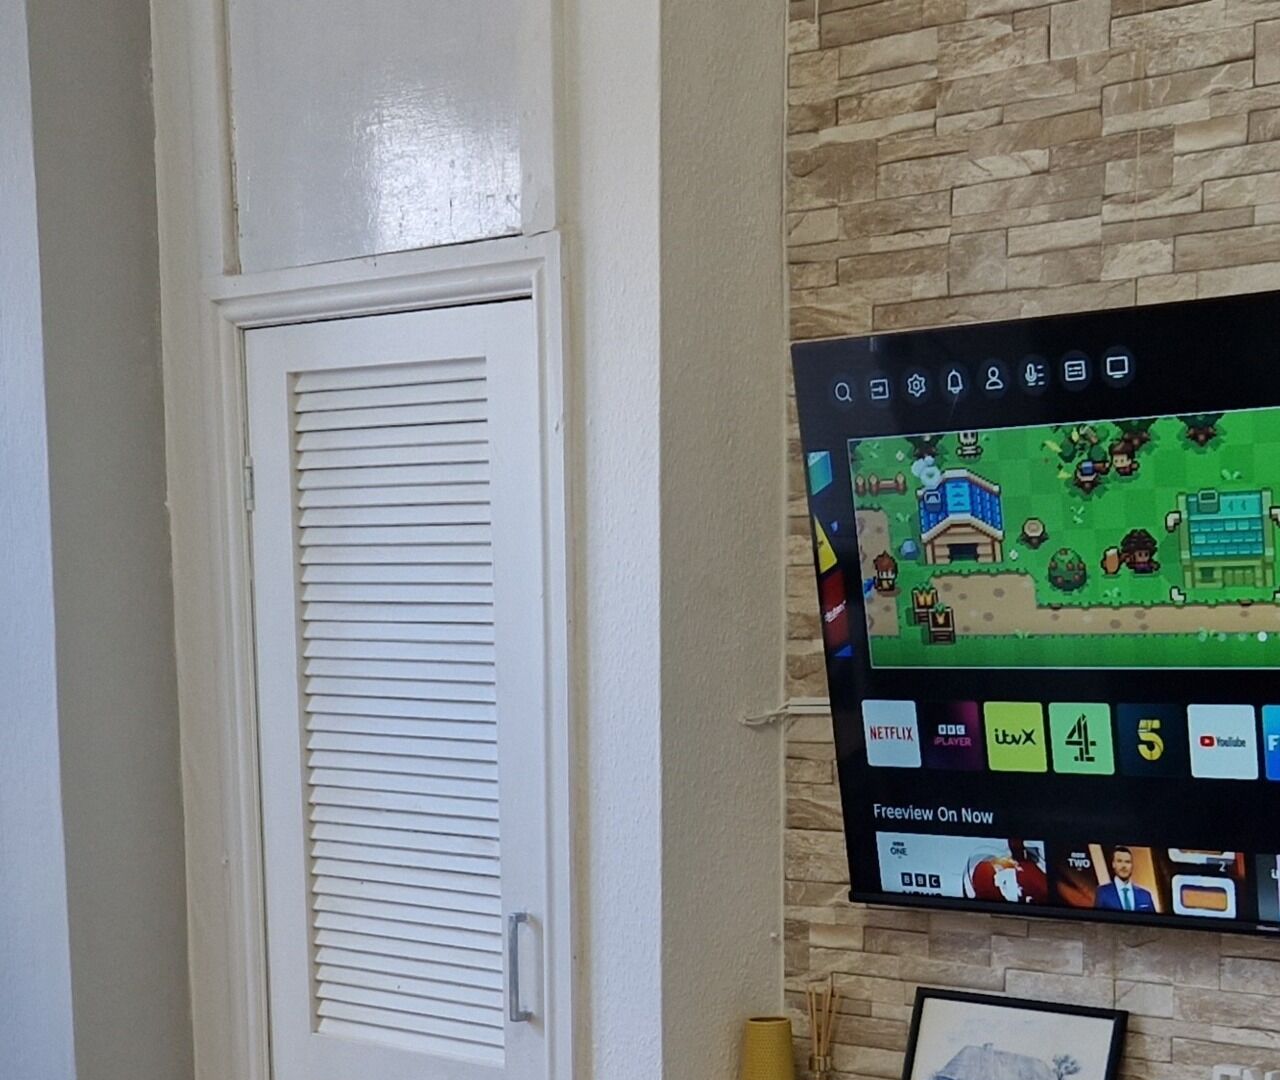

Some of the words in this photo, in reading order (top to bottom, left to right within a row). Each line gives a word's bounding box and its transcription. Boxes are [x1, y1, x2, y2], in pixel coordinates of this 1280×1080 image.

[870, 726, 914, 742] NETFLIX
[994, 728, 1037, 745] itvX
[1065, 713, 1097, 762] 4
[1137, 719, 1164, 761] 5
[1216, 736, 1247, 748] YouTube
[873, 803, 933, 821] Freeview
[937, 806, 958, 823] On
[961, 807, 994, 825] Now
[890, 846, 908, 856] ONE
[1067, 858, 1090, 868] TWO
[1219, 861, 1226, 872] 2
[901, 872, 941, 889] BBC
